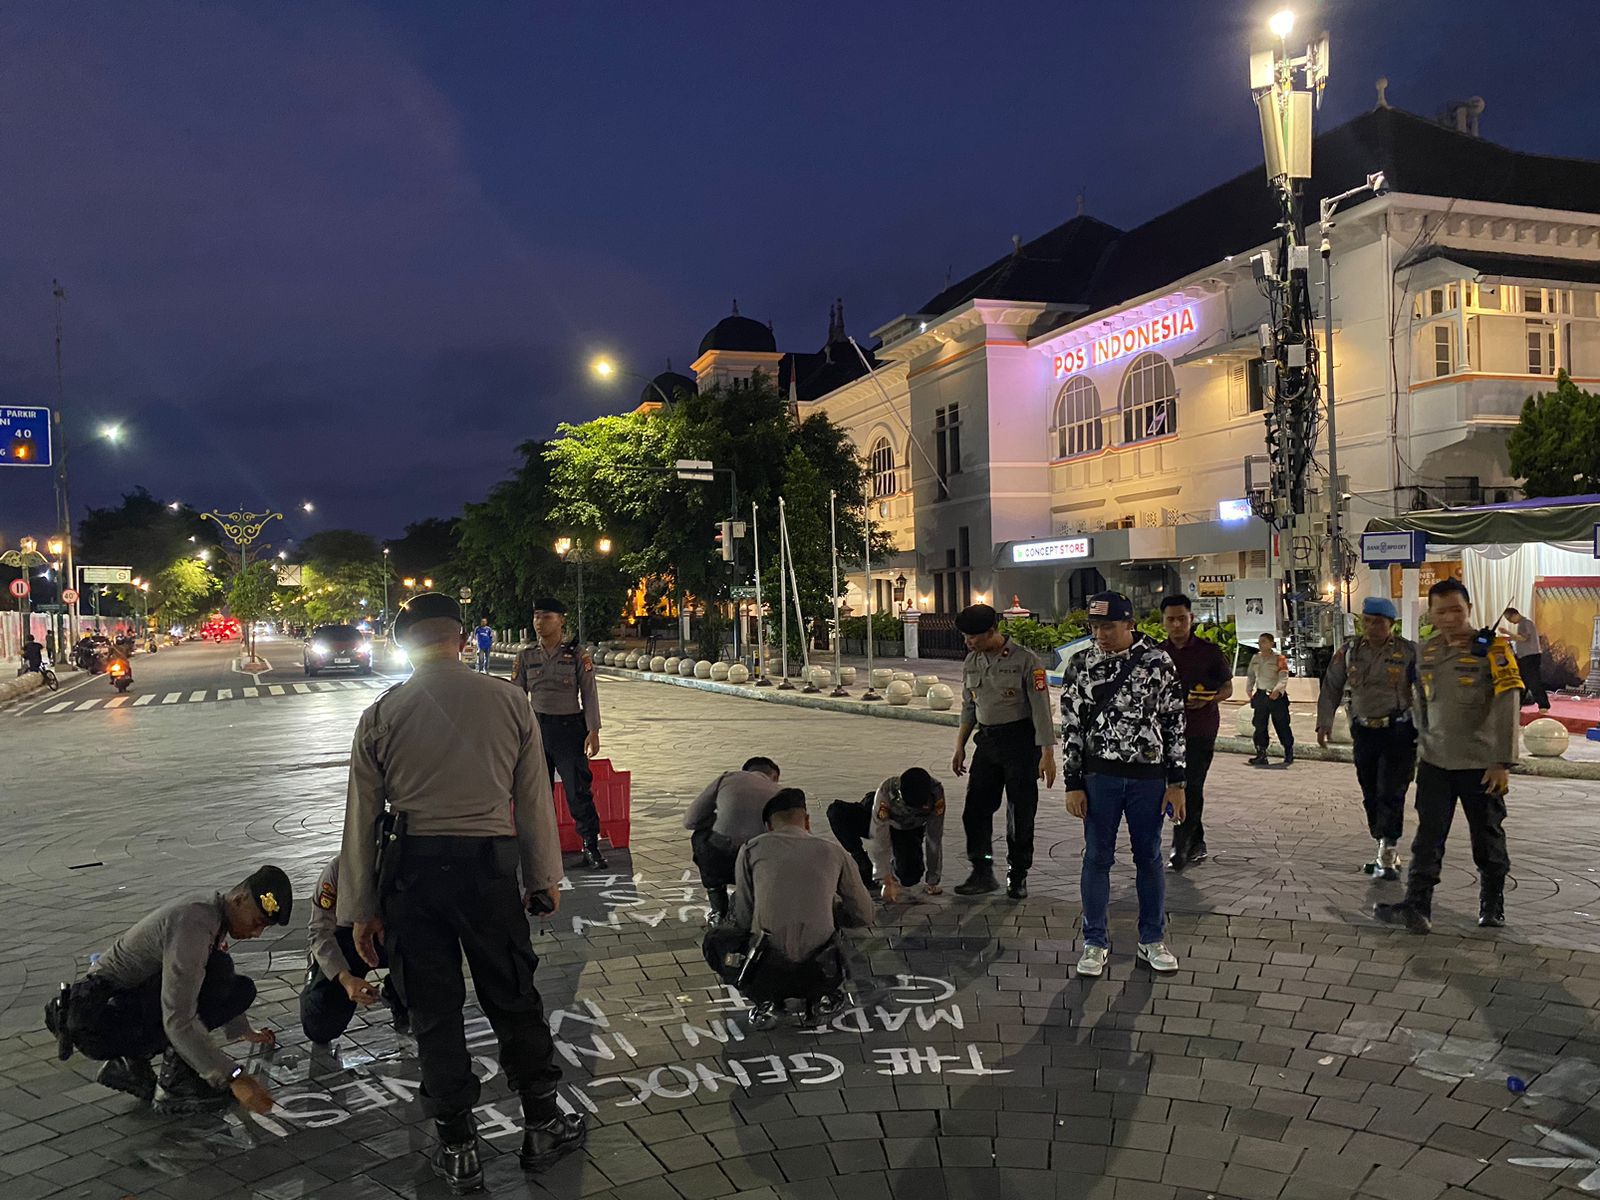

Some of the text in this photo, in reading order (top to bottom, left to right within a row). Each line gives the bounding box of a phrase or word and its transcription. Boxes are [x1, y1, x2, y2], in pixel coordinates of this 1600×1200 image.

[1054, 308, 1195, 378] POS INDONESIA
[7, 410, 37, 419] PARKIR
[1025, 543, 1085, 557] CONCEPT STORE
[796, 1003, 965, 1035] MAD
[471, 1042, 1015, 1140] THE GENOCIE
